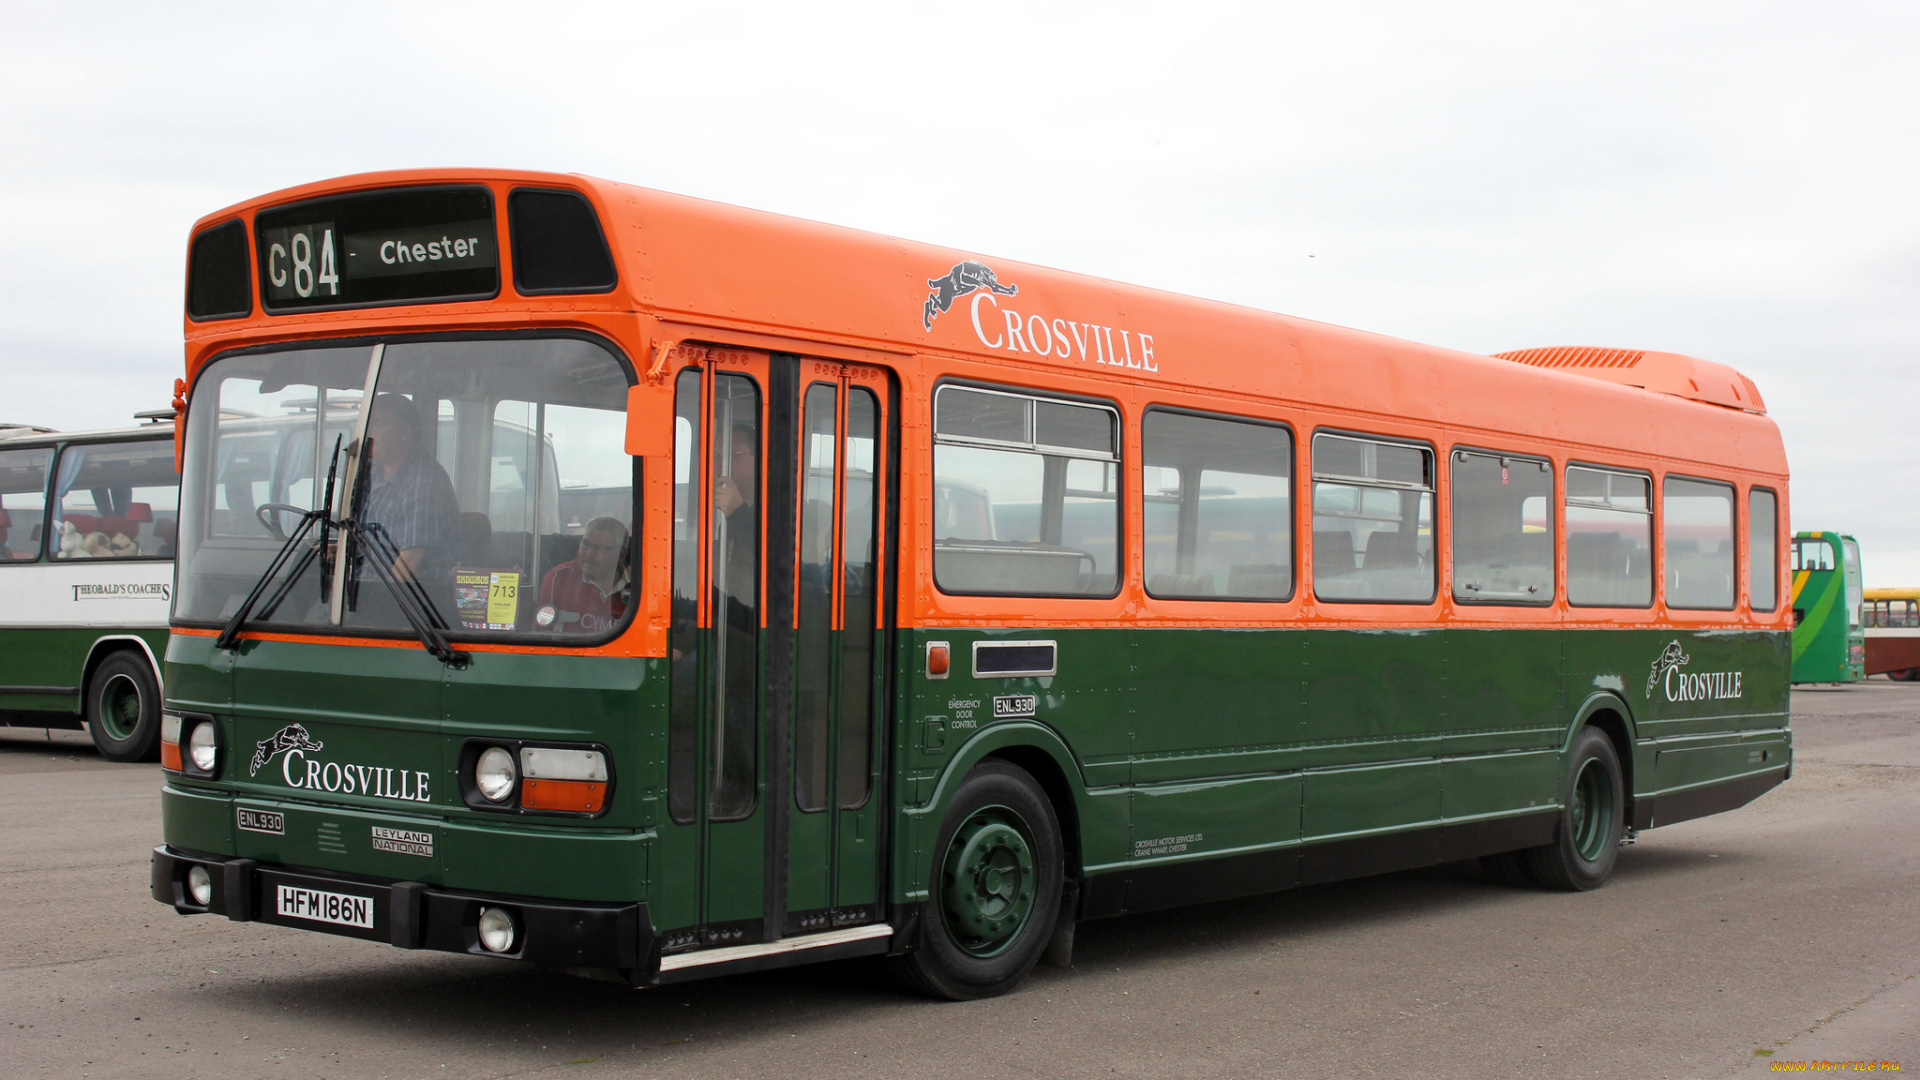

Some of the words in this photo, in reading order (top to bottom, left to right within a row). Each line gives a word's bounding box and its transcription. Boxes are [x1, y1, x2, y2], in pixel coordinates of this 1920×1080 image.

[379, 235, 479, 265] Chester
[970, 292, 1159, 373] CROSVILLE
[72, 584, 126, 601] THEOBALD'S
[127, 583, 170, 601] COACHES
[492, 585, 516, 598] 713
[1665, 664, 1742, 702] CROSVILLE
[948, 700, 981, 709] EMERGENCY
[996, 699, 1033, 713] ENL930
[956, 710, 973, 719] DOOR
[951, 720, 978, 729] CONTROL
[282, 749, 431, 803] CROSVILLE
[239, 811, 282, 830] ENL930
[375, 828, 430, 843] LEYLAND
[1135, 839, 1158, 848] CROSVILLE
[374, 839, 432, 856] NATIONAL
[1169, 844, 1187, 852] CHESTER
[283, 888, 367, 925] HFM186N
